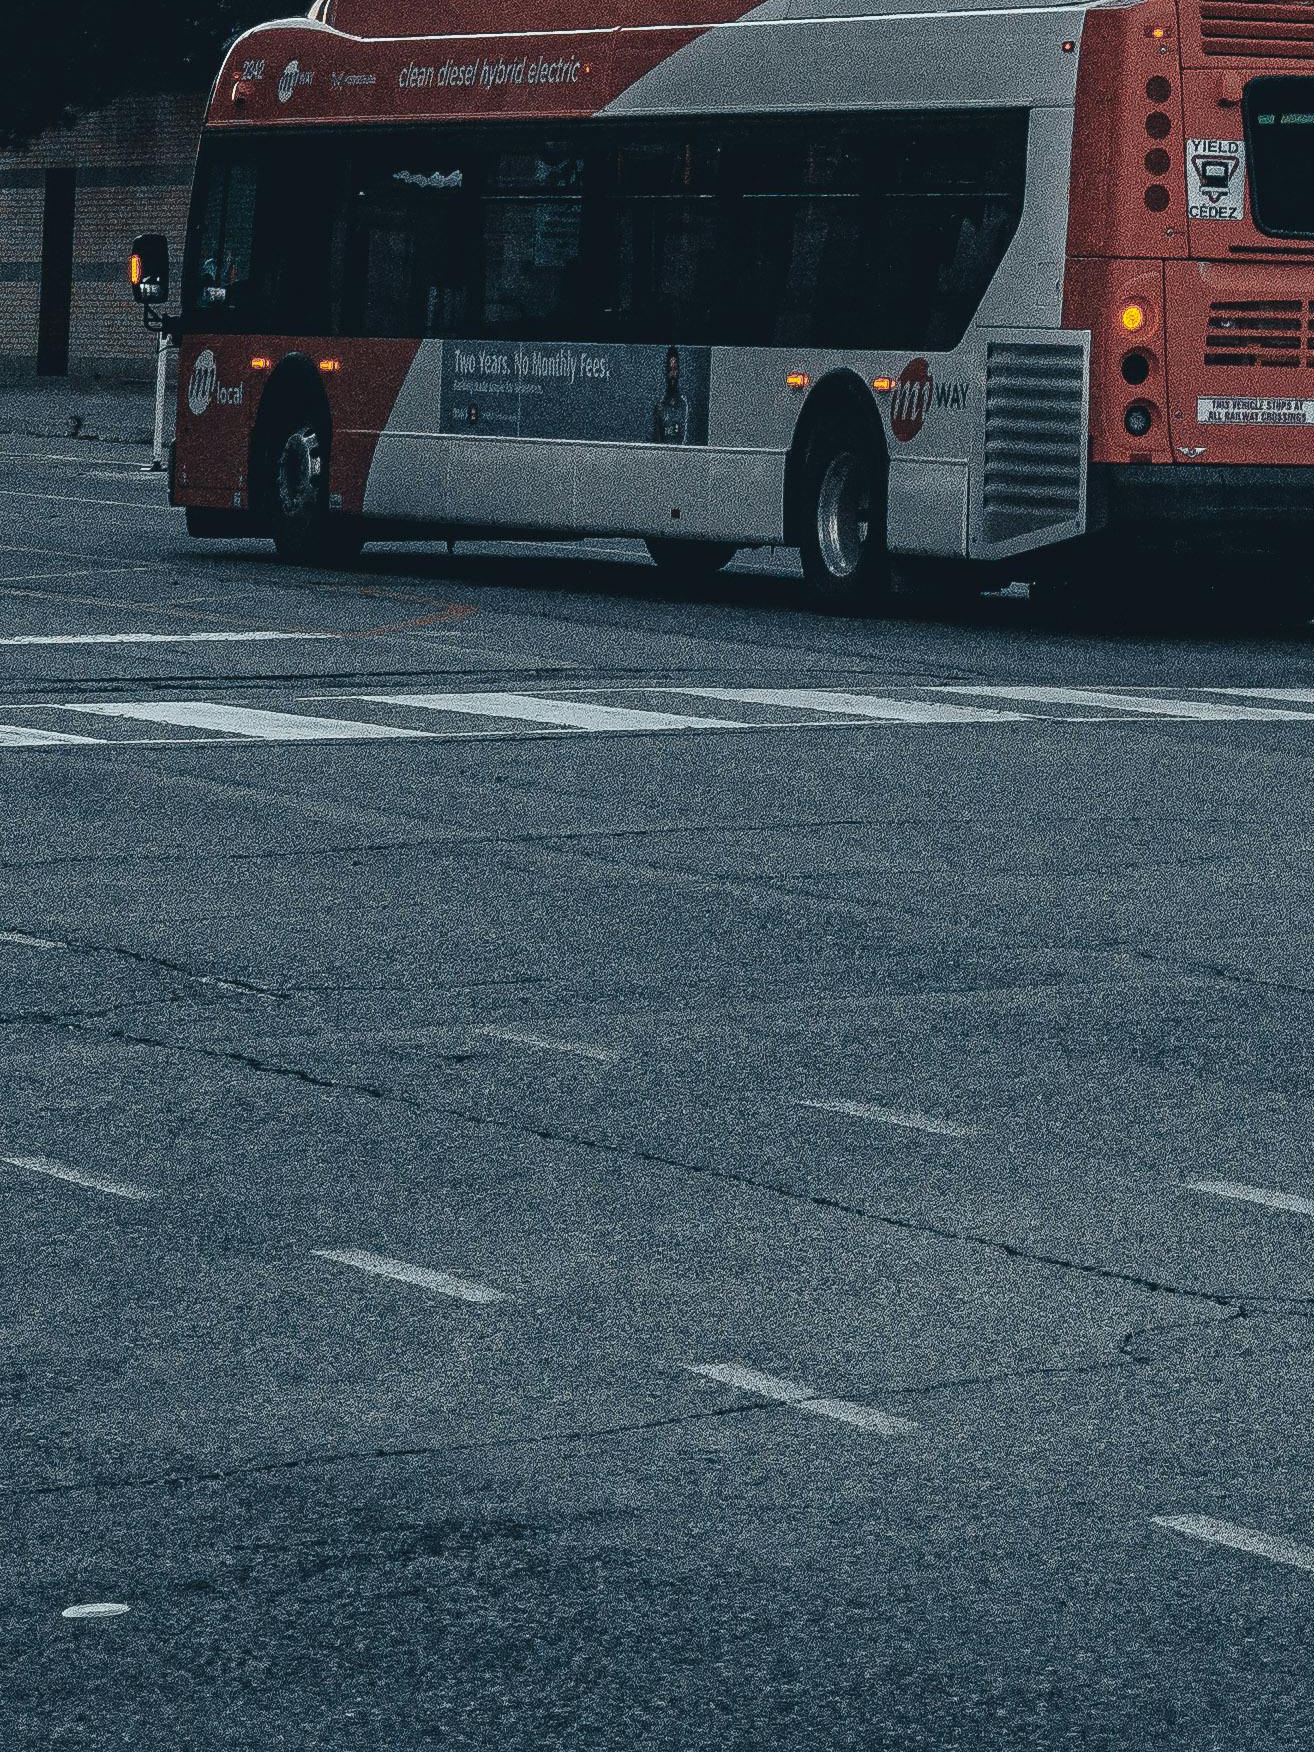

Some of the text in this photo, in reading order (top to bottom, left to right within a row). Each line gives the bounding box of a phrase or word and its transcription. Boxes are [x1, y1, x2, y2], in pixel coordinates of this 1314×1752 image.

[398, 61, 434, 88] clean
[437, 58, 480, 86] diesel
[479, 55, 526, 90] hybrid
[527, 54, 580, 84] electric
[1192, 140, 1239, 154] YIELD
[1189, 204, 1238, 219] CÉDEZ
[454, 349, 476, 374] Two
[478, 349, 511, 375] Years.
[513, 350, 529, 375] No
[531, 349, 577, 385] Monthly
[216, 380, 244, 405] local
[1212, 400, 1304, 411] THIS VEHICLE STOPS AT
[1208, 411, 1307, 423] ALL RAILWAY CROSSINGS
